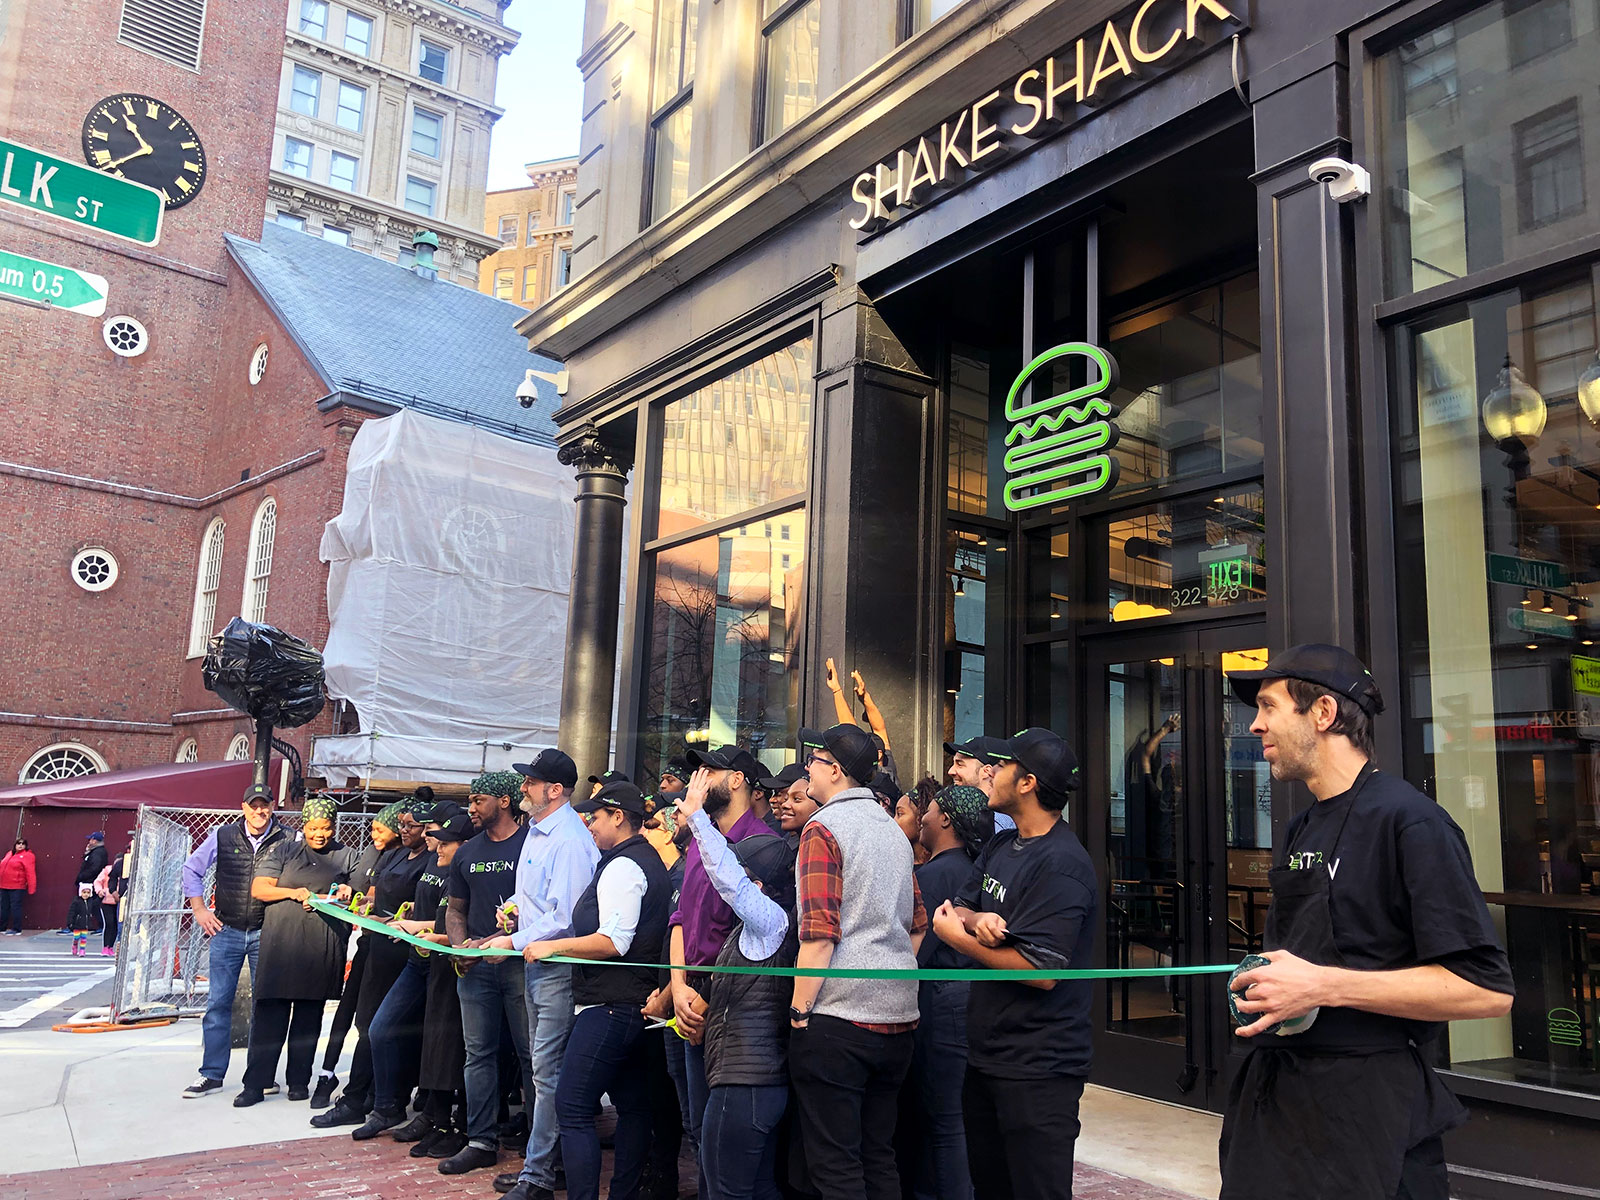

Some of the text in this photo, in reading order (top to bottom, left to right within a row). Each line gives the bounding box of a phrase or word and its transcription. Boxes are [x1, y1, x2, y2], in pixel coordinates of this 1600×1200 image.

[848, 0, 1231, 230] SHAKE SHACK
[0, 152, 104, 223] LK ST
[32, 270, 65, 299] 0.5
[1171, 582, 1240, 608] 322-328
